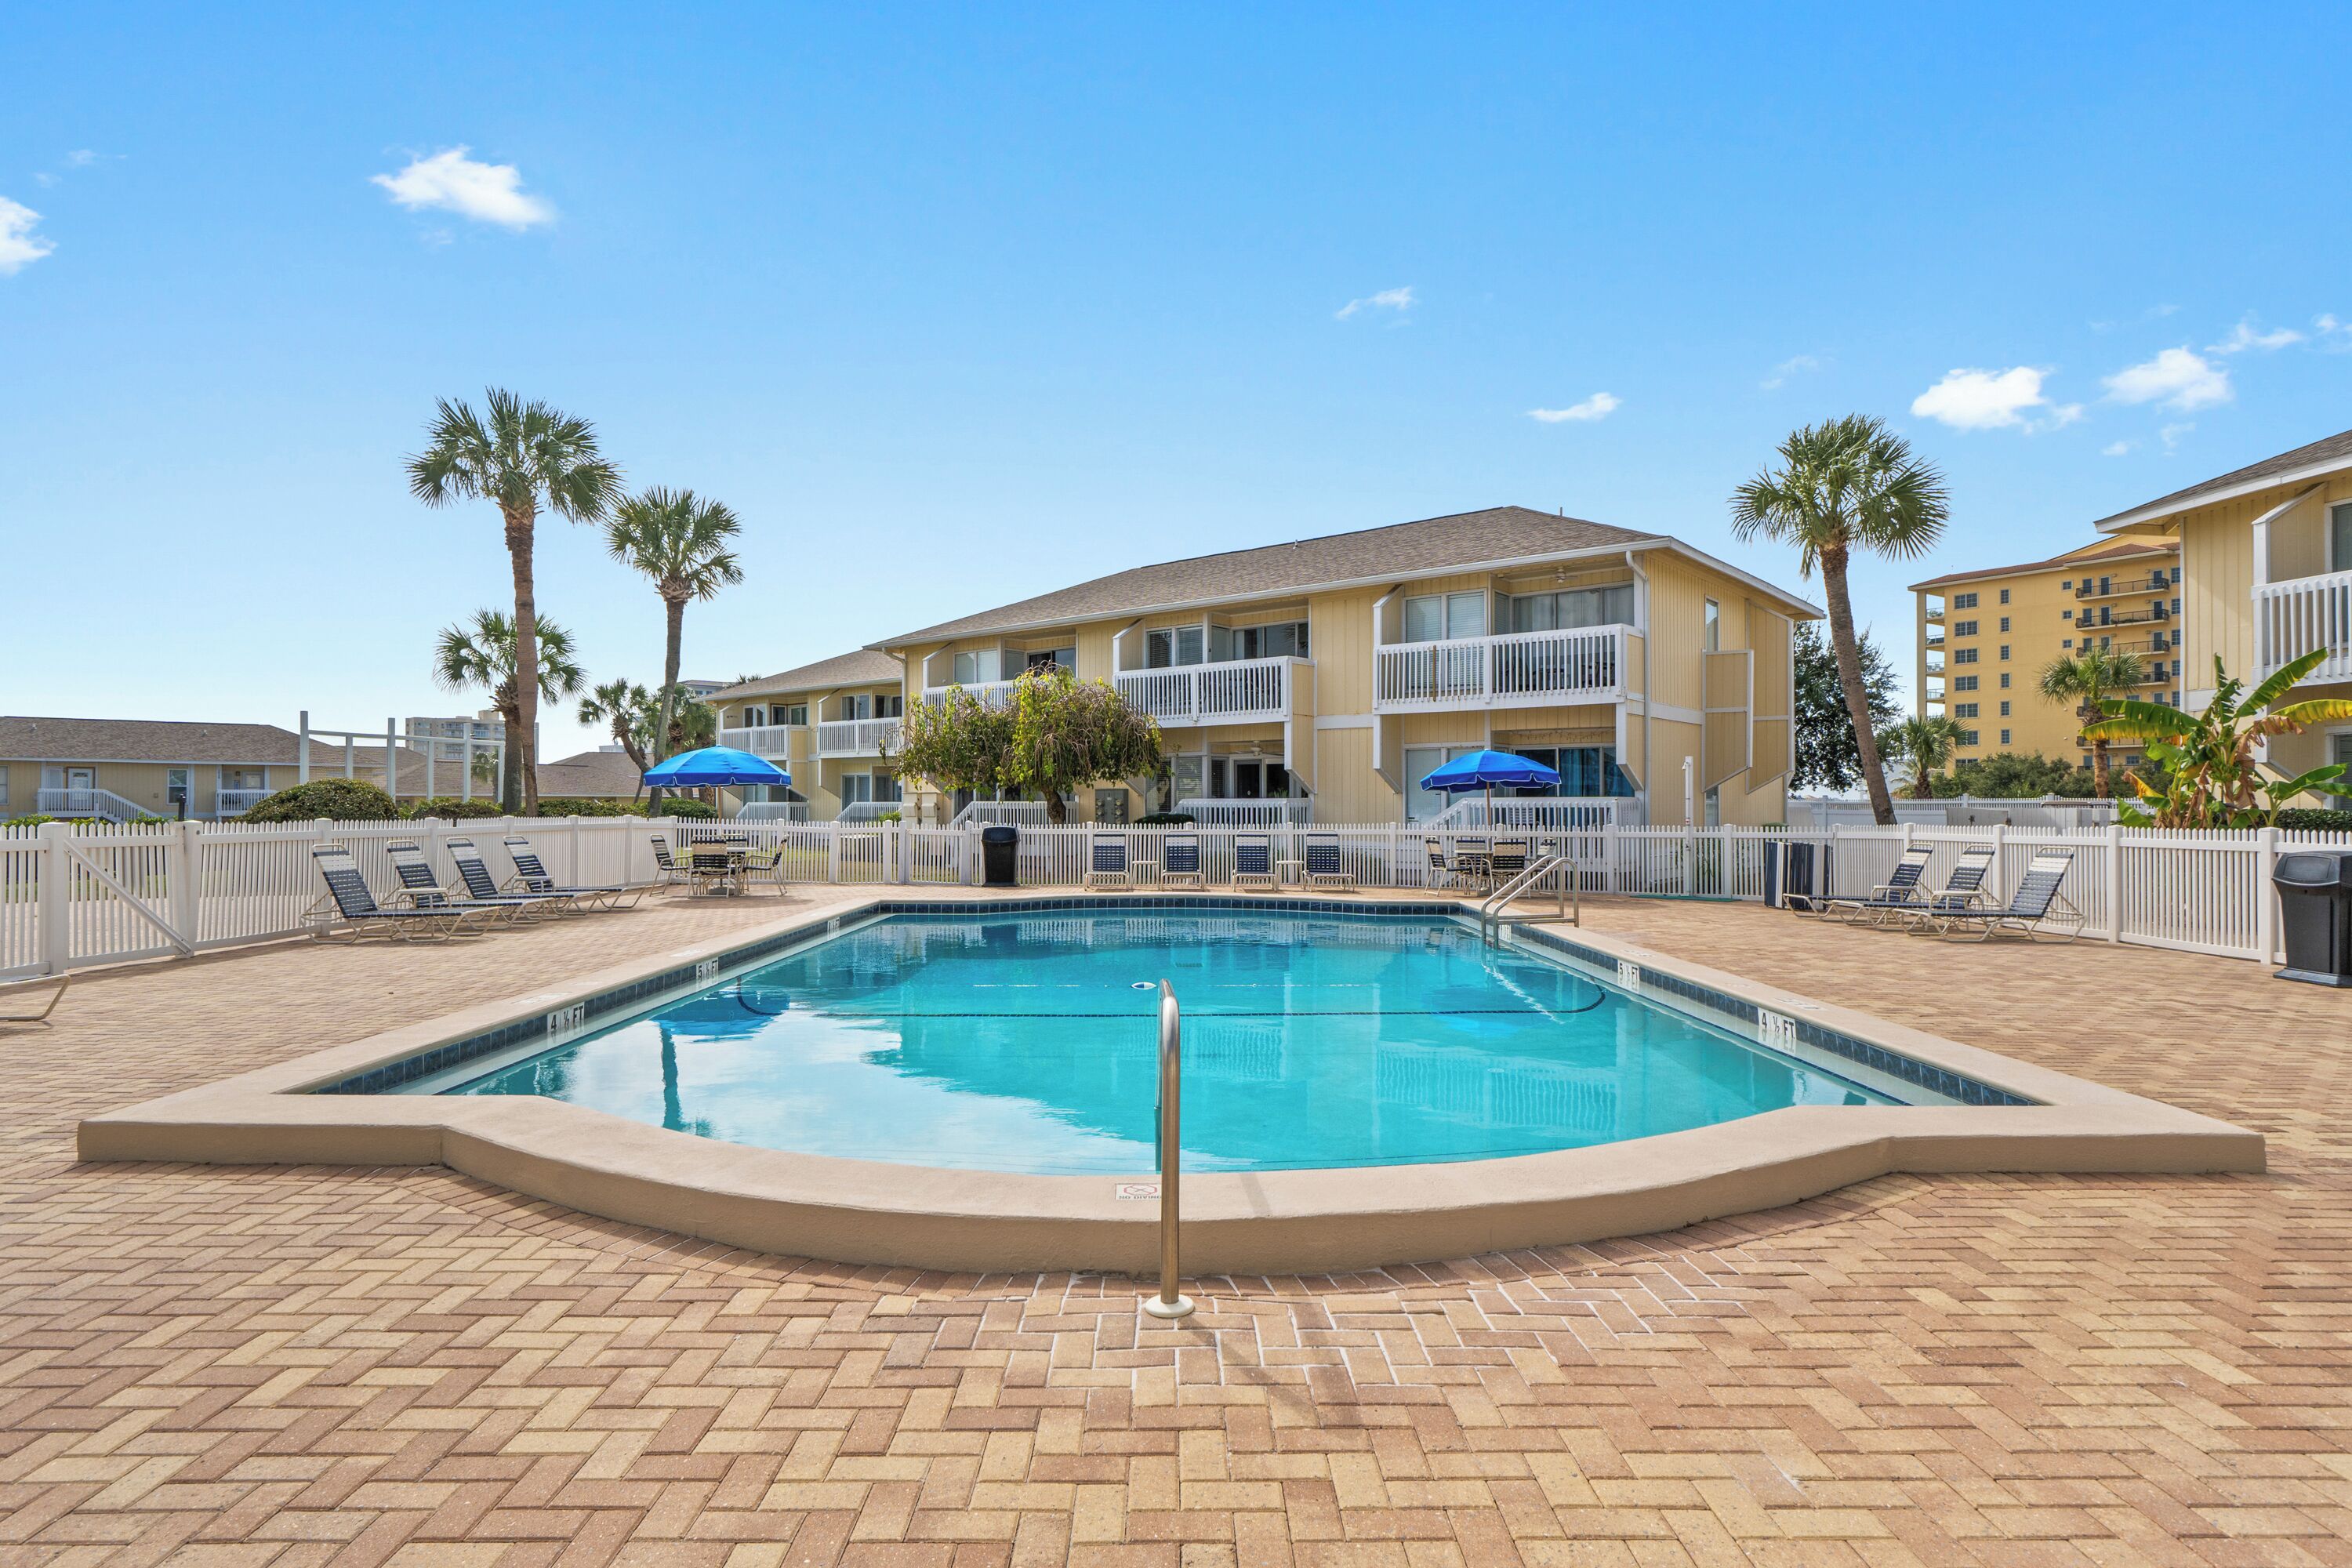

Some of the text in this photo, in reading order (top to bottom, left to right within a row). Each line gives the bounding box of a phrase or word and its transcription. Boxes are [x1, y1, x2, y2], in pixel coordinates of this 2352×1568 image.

[698, 964, 702, 978] 5
[1619, 962, 1624, 975] 5
[551, 1014, 557, 1030] 4
[573, 1005, 583, 1023] FT
[1762, 1012, 1767, 1029] 4
